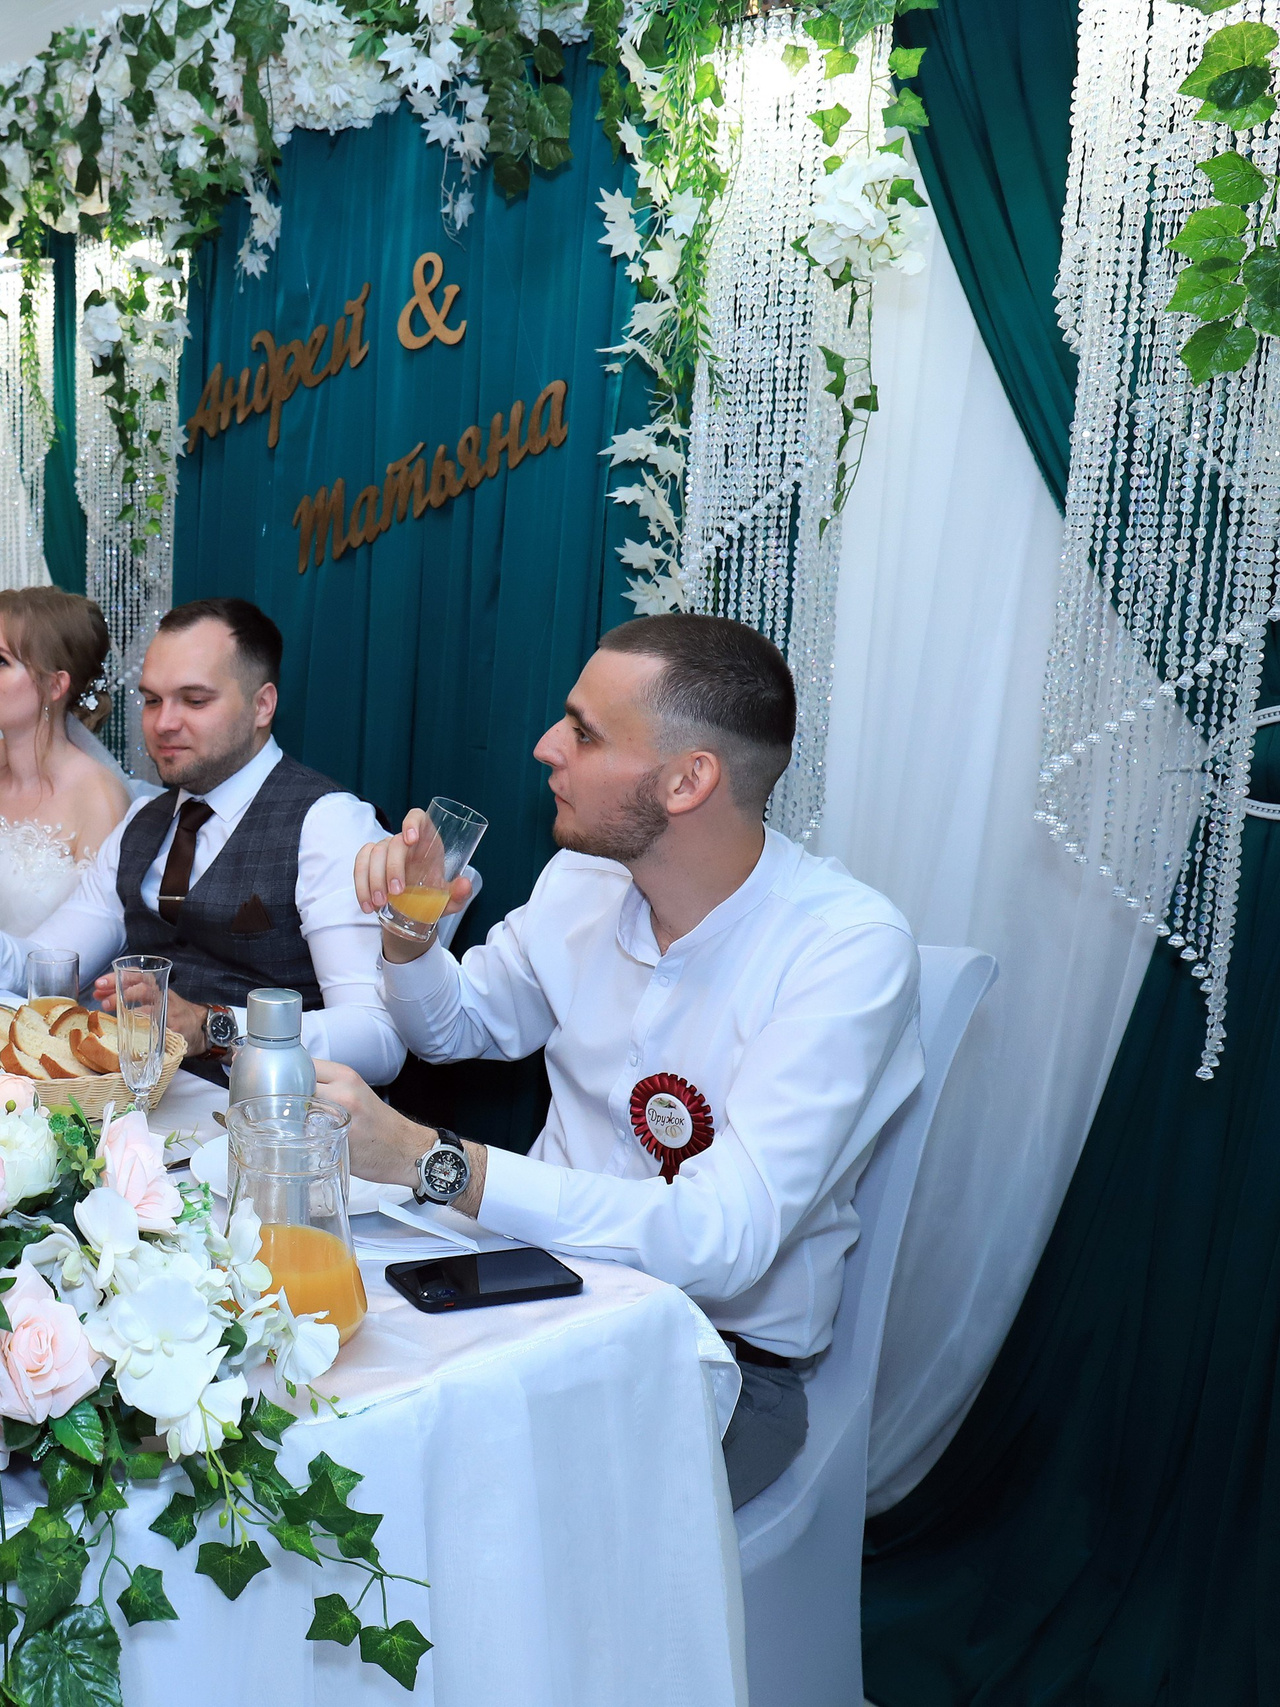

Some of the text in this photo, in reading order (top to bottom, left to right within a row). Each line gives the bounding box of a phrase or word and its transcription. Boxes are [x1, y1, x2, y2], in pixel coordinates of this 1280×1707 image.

[186, 252, 467, 453] Андрей &
[292, 379, 568, 574] Татьяна
[648, 1108, 685, 1126] Дружок
